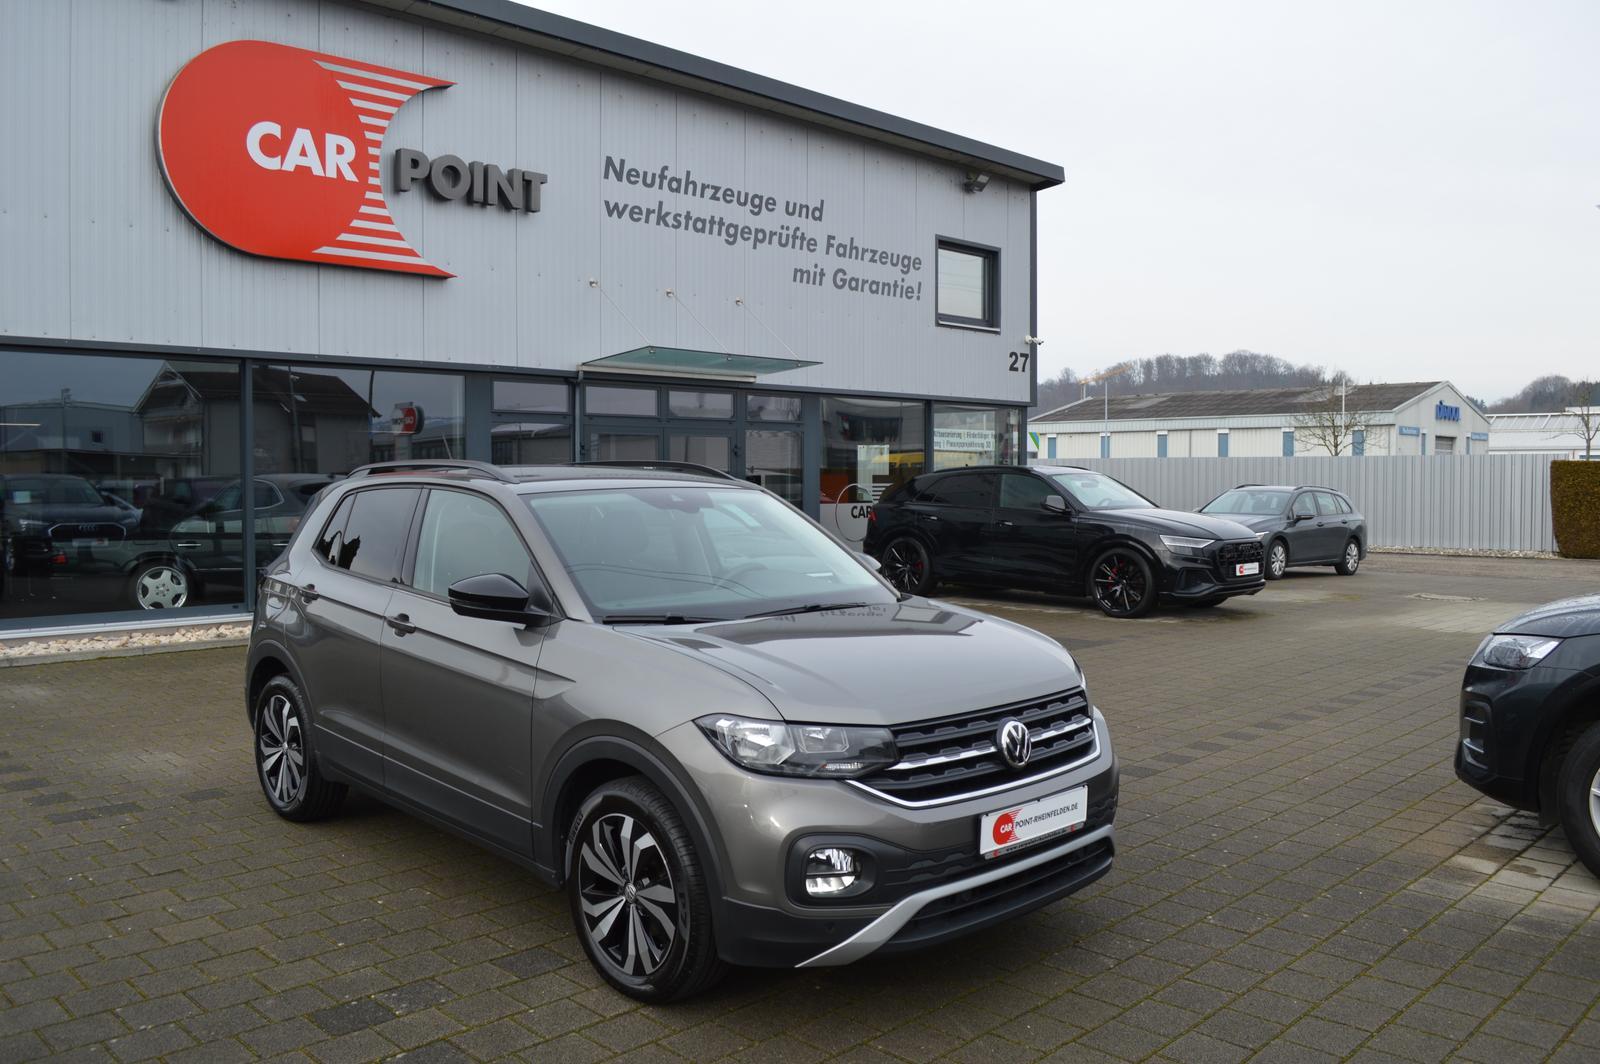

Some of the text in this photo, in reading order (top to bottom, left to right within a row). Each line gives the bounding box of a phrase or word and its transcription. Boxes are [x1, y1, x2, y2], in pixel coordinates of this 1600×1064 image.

[246, 121, 548, 213] CAR POINT
[603, 156, 825, 222] Neufahrzeuge und
[603, 200, 922, 274] werkstattgeprüfte Fahrzeuge
[793, 264, 922, 300] mit Garantie!
[1009, 351, 1029, 372] 27
[1000, 802, 1079, 833] CAR POINT-RHEINFELDEN.DE
